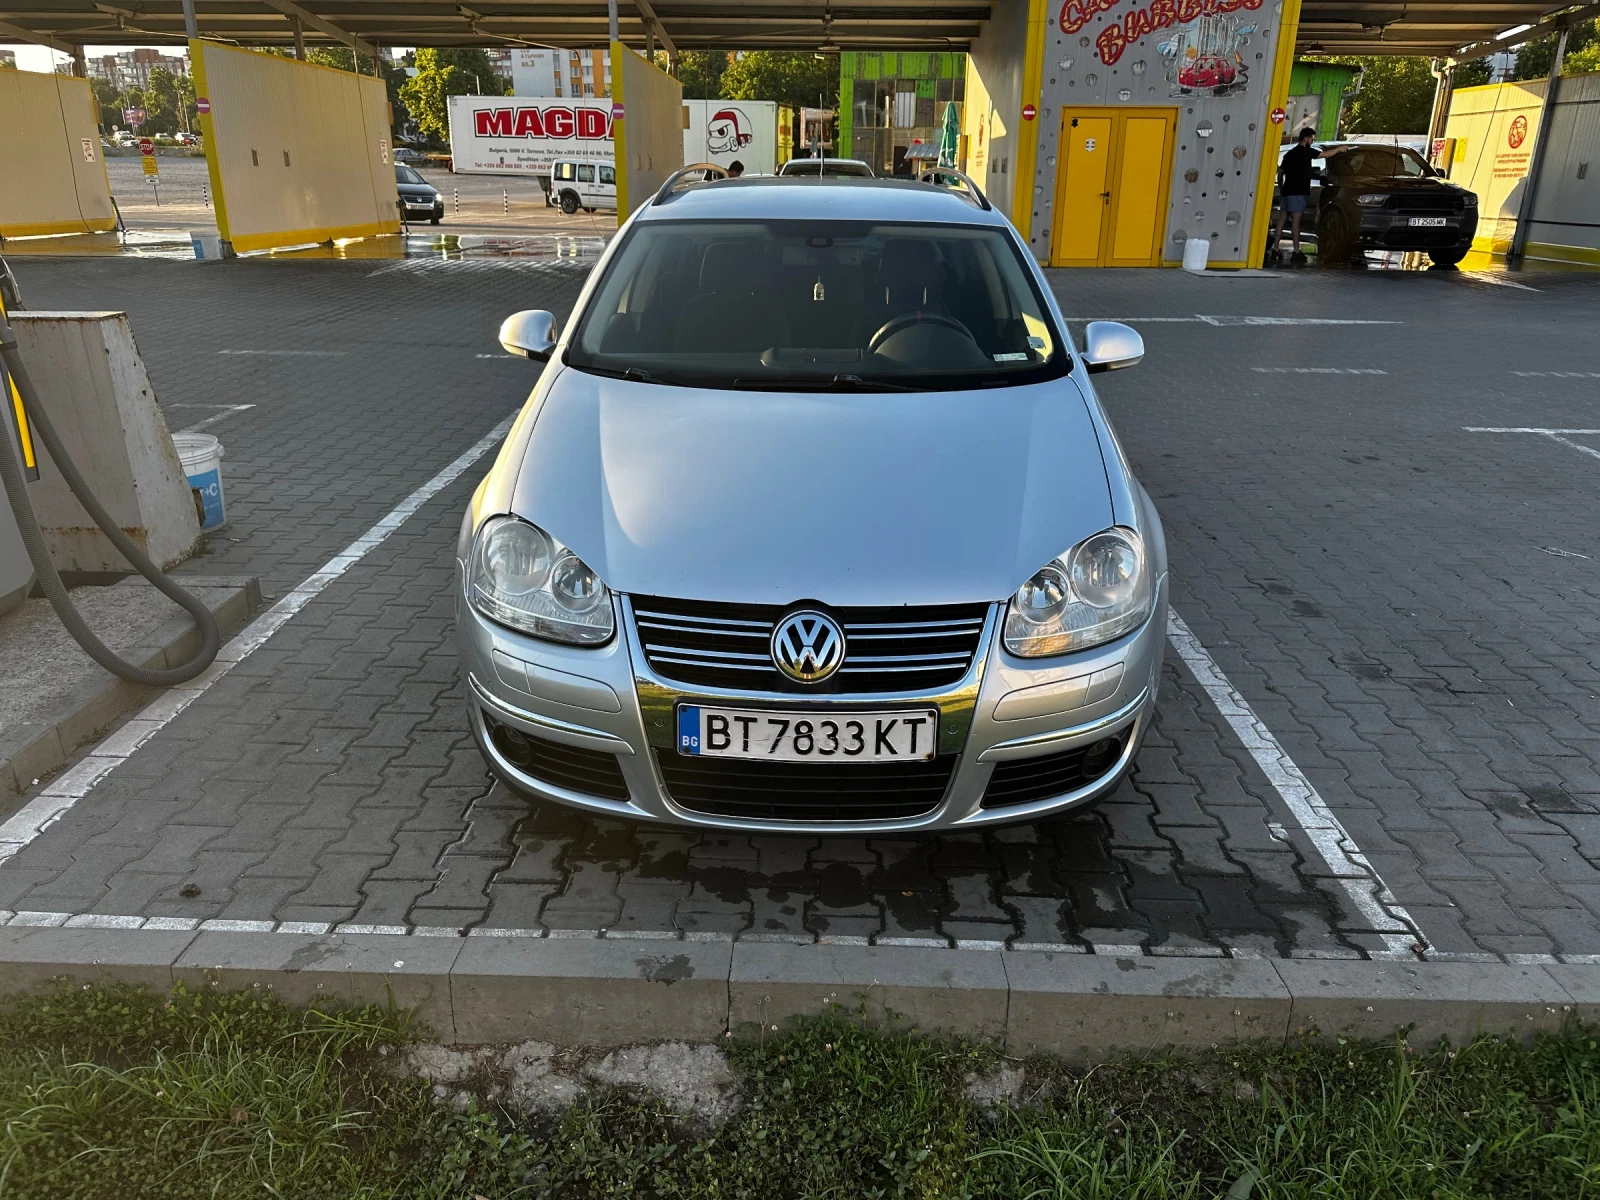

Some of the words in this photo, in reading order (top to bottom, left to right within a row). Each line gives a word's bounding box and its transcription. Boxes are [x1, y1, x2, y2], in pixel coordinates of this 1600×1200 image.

[1096, 0, 1264, 66] BUBB
[473, 106, 614, 141] MAGD
[140, 143, 153, 151] STOP
[1421, 218, 1436, 226] 2505
[682, 735, 698, 747] BG
[706, 714, 758, 752] BT
[767, 718, 865, 756] 7833
[874, 717, 927, 755] KT
